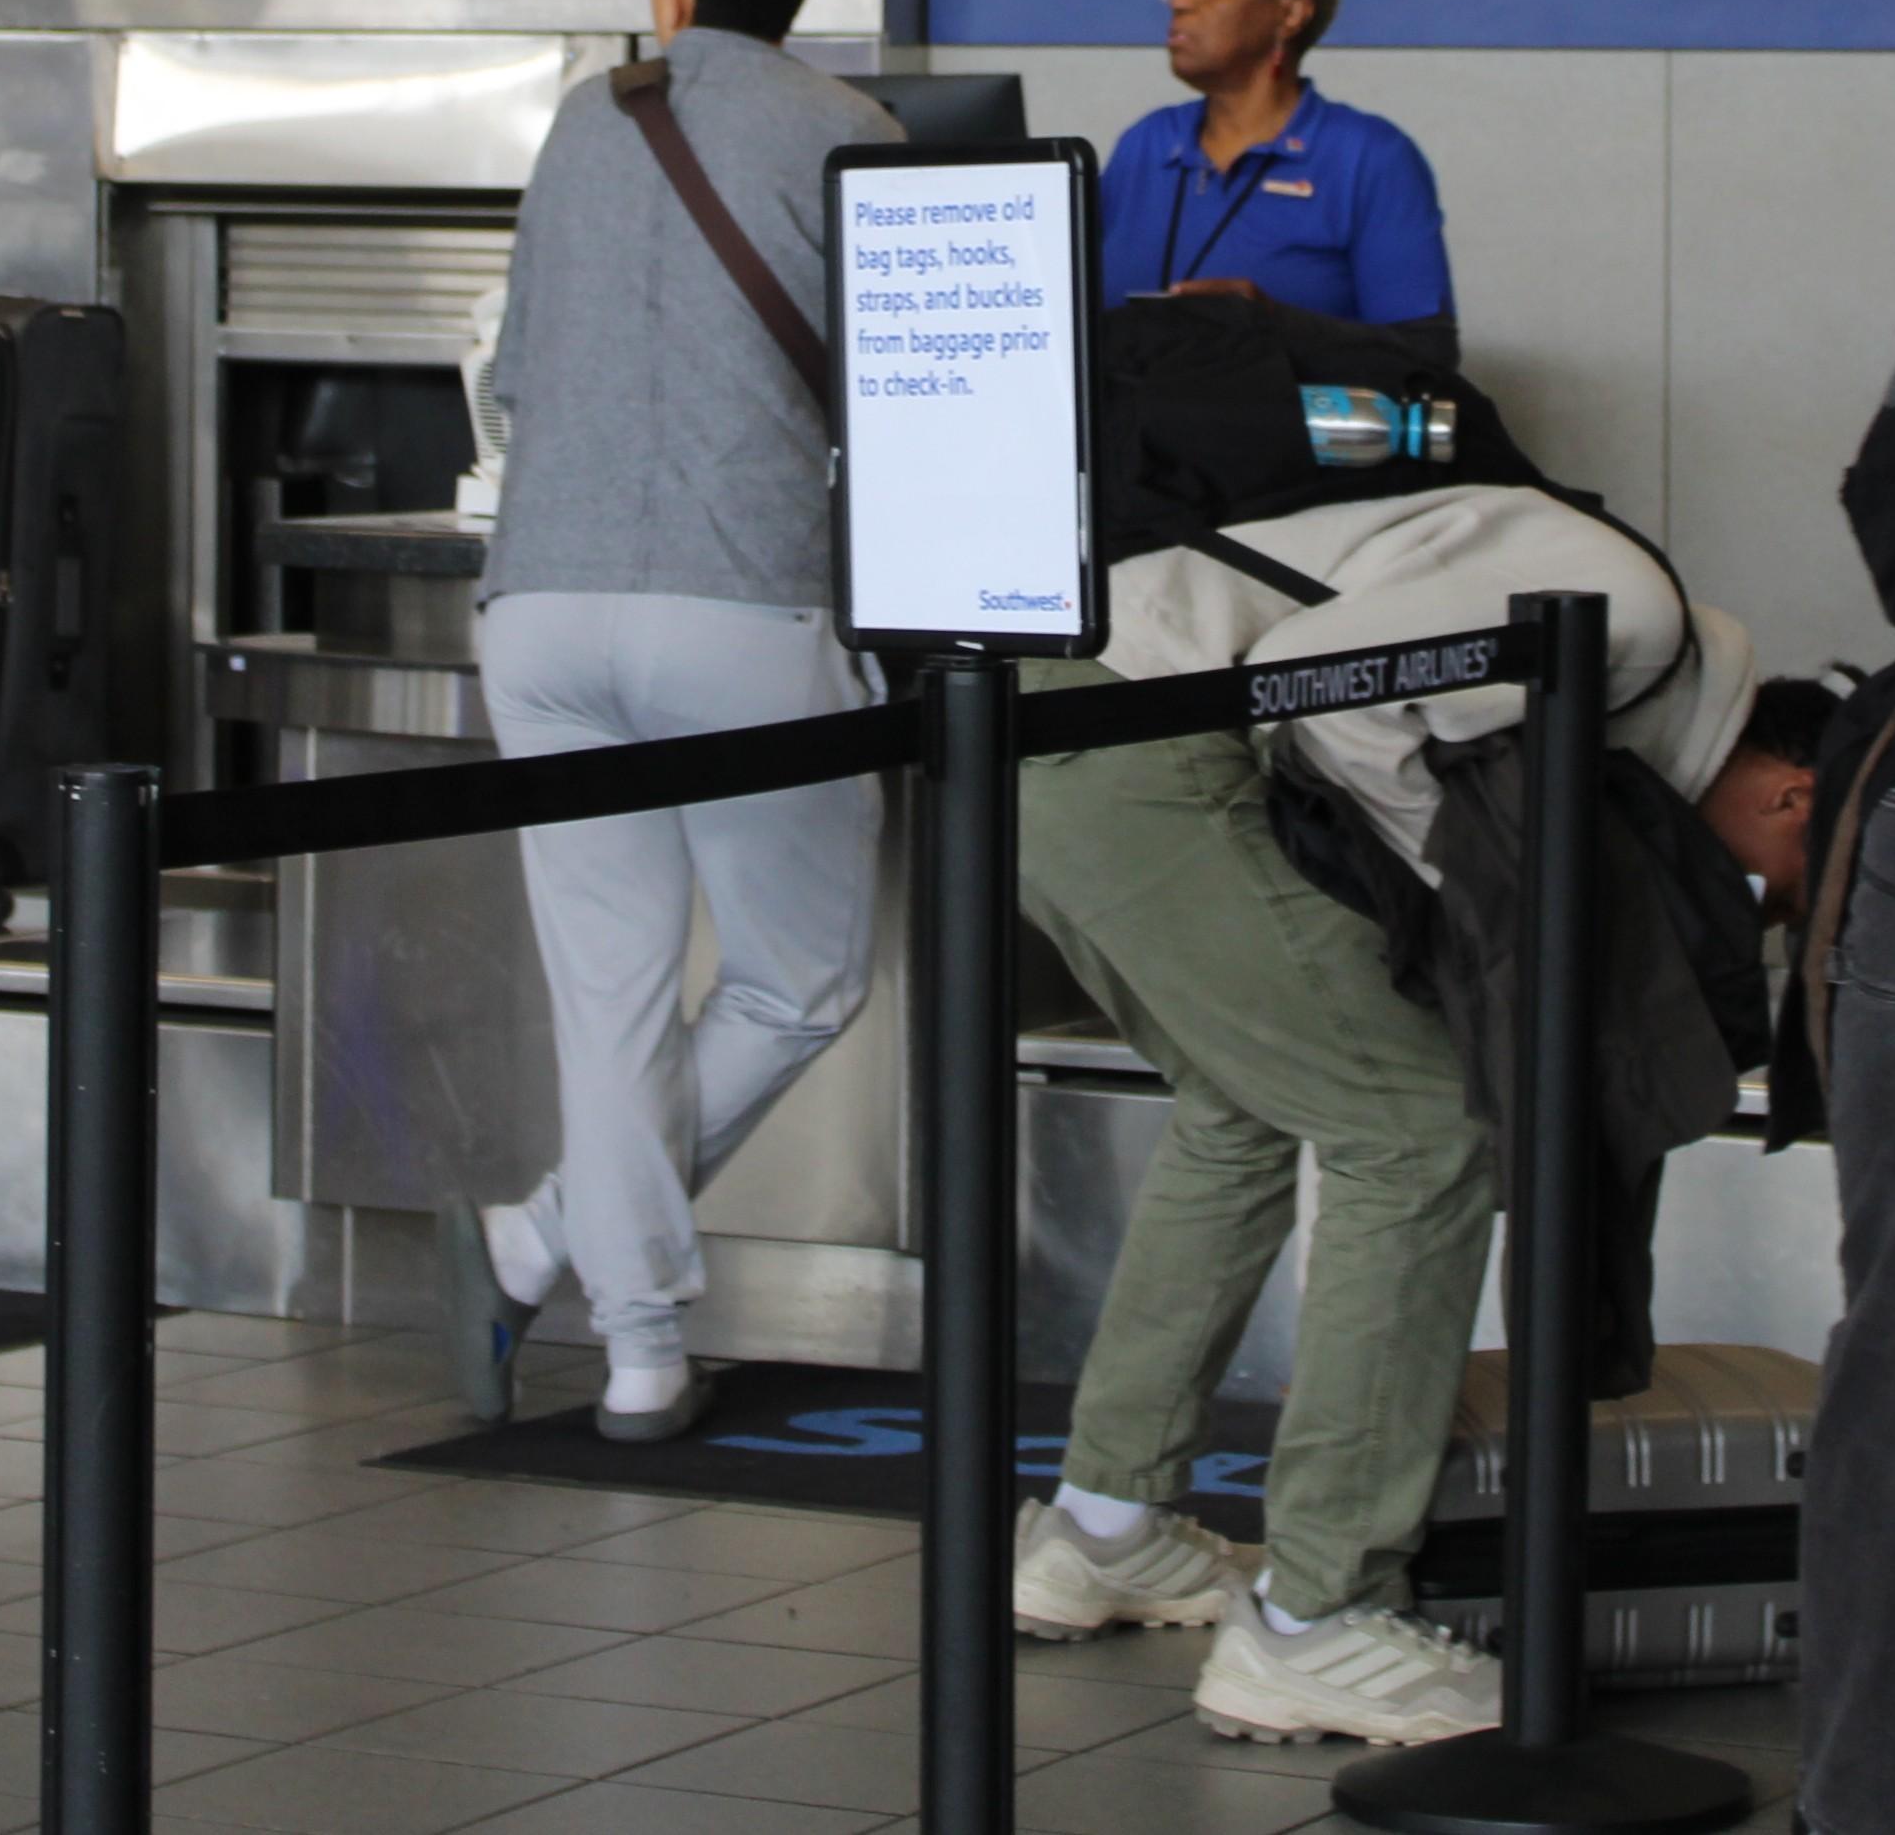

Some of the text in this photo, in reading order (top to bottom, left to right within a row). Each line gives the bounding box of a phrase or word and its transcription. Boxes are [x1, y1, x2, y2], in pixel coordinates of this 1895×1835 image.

[856, 193, 1035, 226] Please remove old
[856, 239, 1015, 276] bag tags, hooks,
[857, 281, 1043, 318] straps, and buckles
[858, 324, 1050, 360] from baggage prior
[859, 370, 974, 397] to check-in.
[979, 589, 1064, 611] Southwest
[1250, 656, 1388, 715] SOUTHWEST
